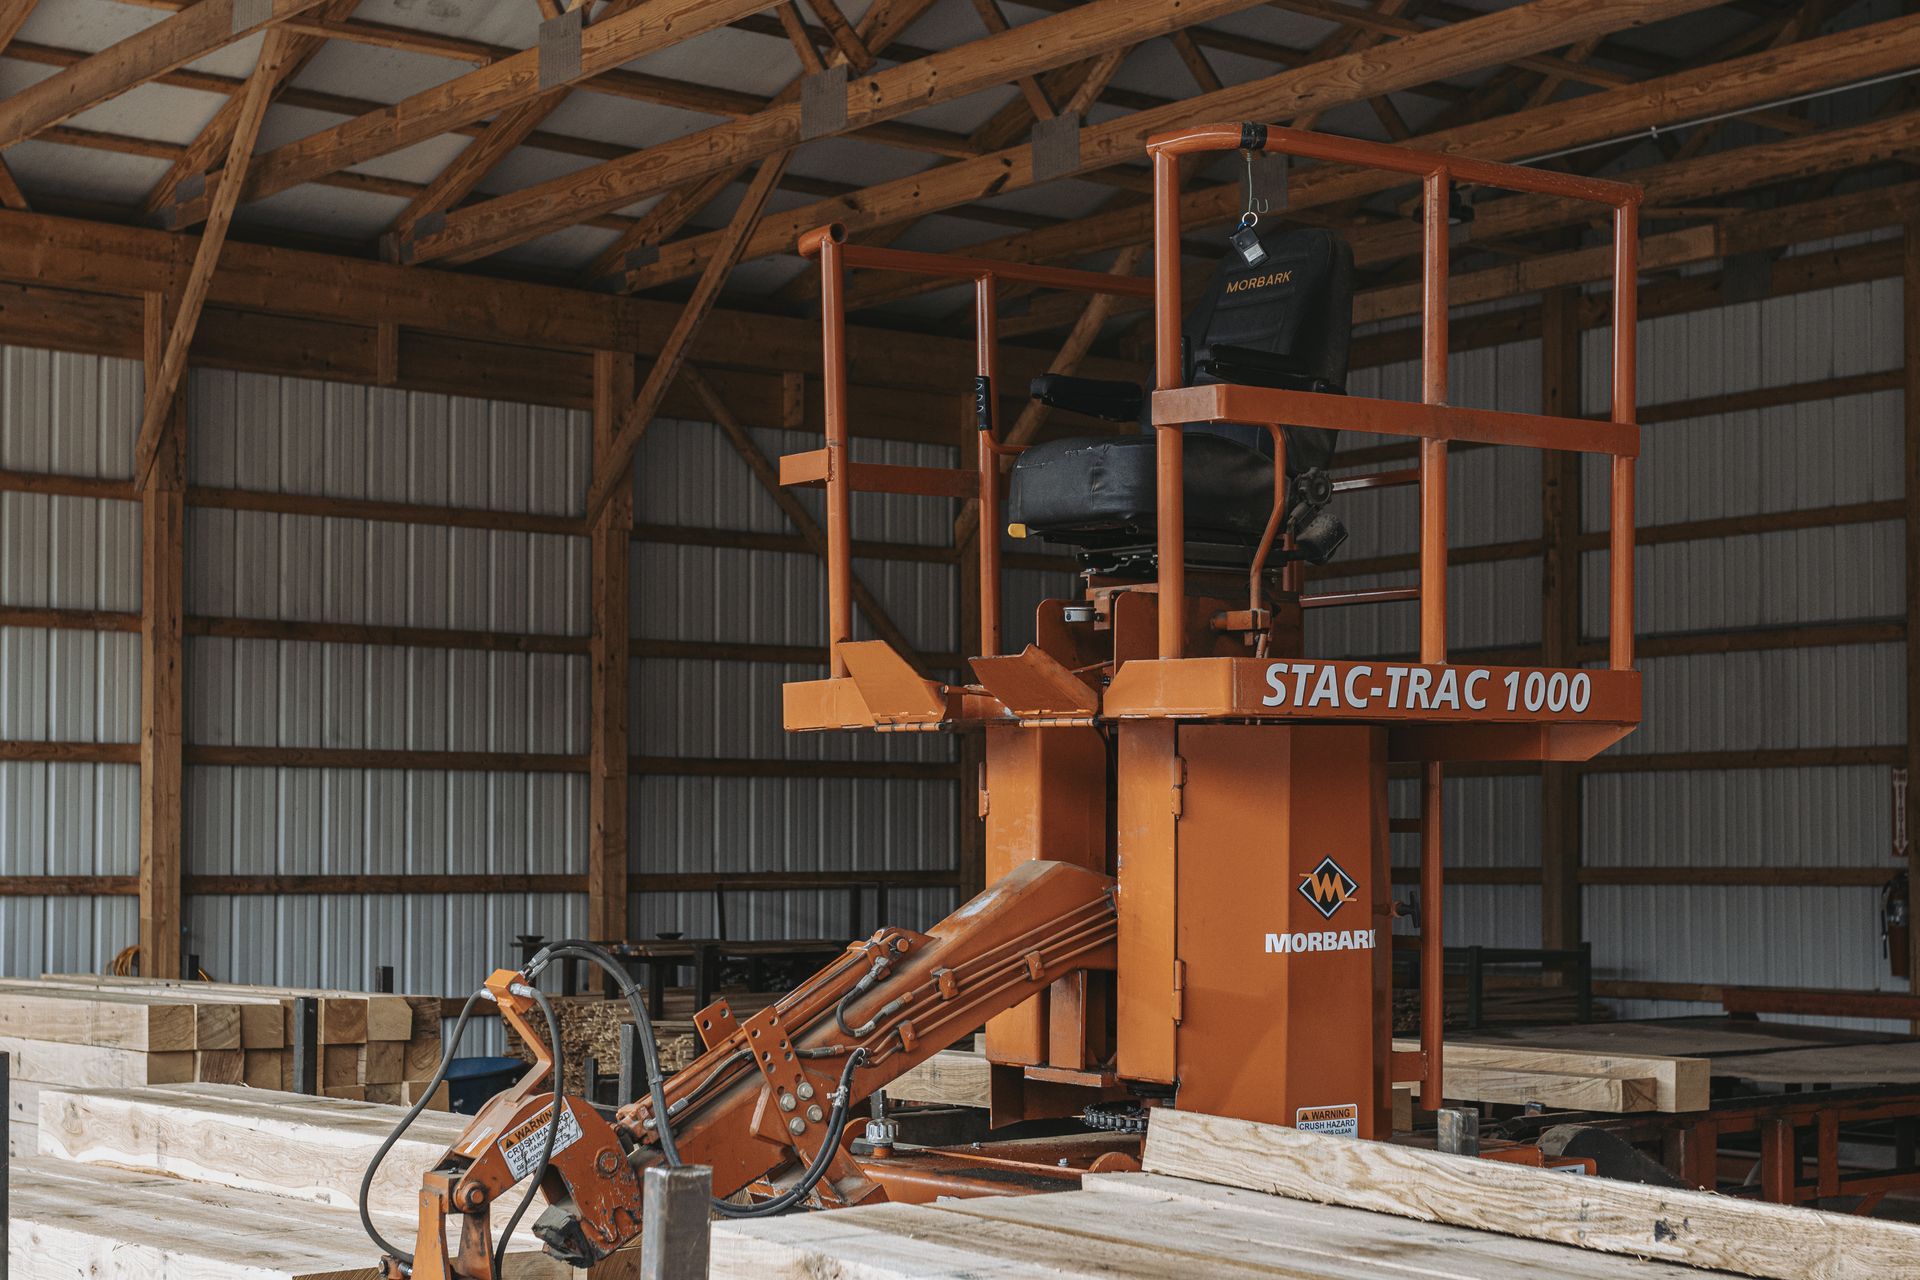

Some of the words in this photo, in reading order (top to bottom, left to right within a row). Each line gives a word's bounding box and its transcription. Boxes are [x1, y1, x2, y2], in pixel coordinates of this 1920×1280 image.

[1226, 270, 1292, 294] MORBARK
[1262, 662, 1491, 710] STAC-TRAC
[1503, 671, 1591, 713] 1000
[515, 1110, 553, 1140] WARNIN
[1300, 1122, 1325, 1131] CRUSH
[1327, 1119, 1356, 1129] HAZARD
[1311, 1109, 1350, 1120] WARNING
[506, 1134, 536, 1159] CRUSH
[527, 1149, 545, 1163] MOVIN
